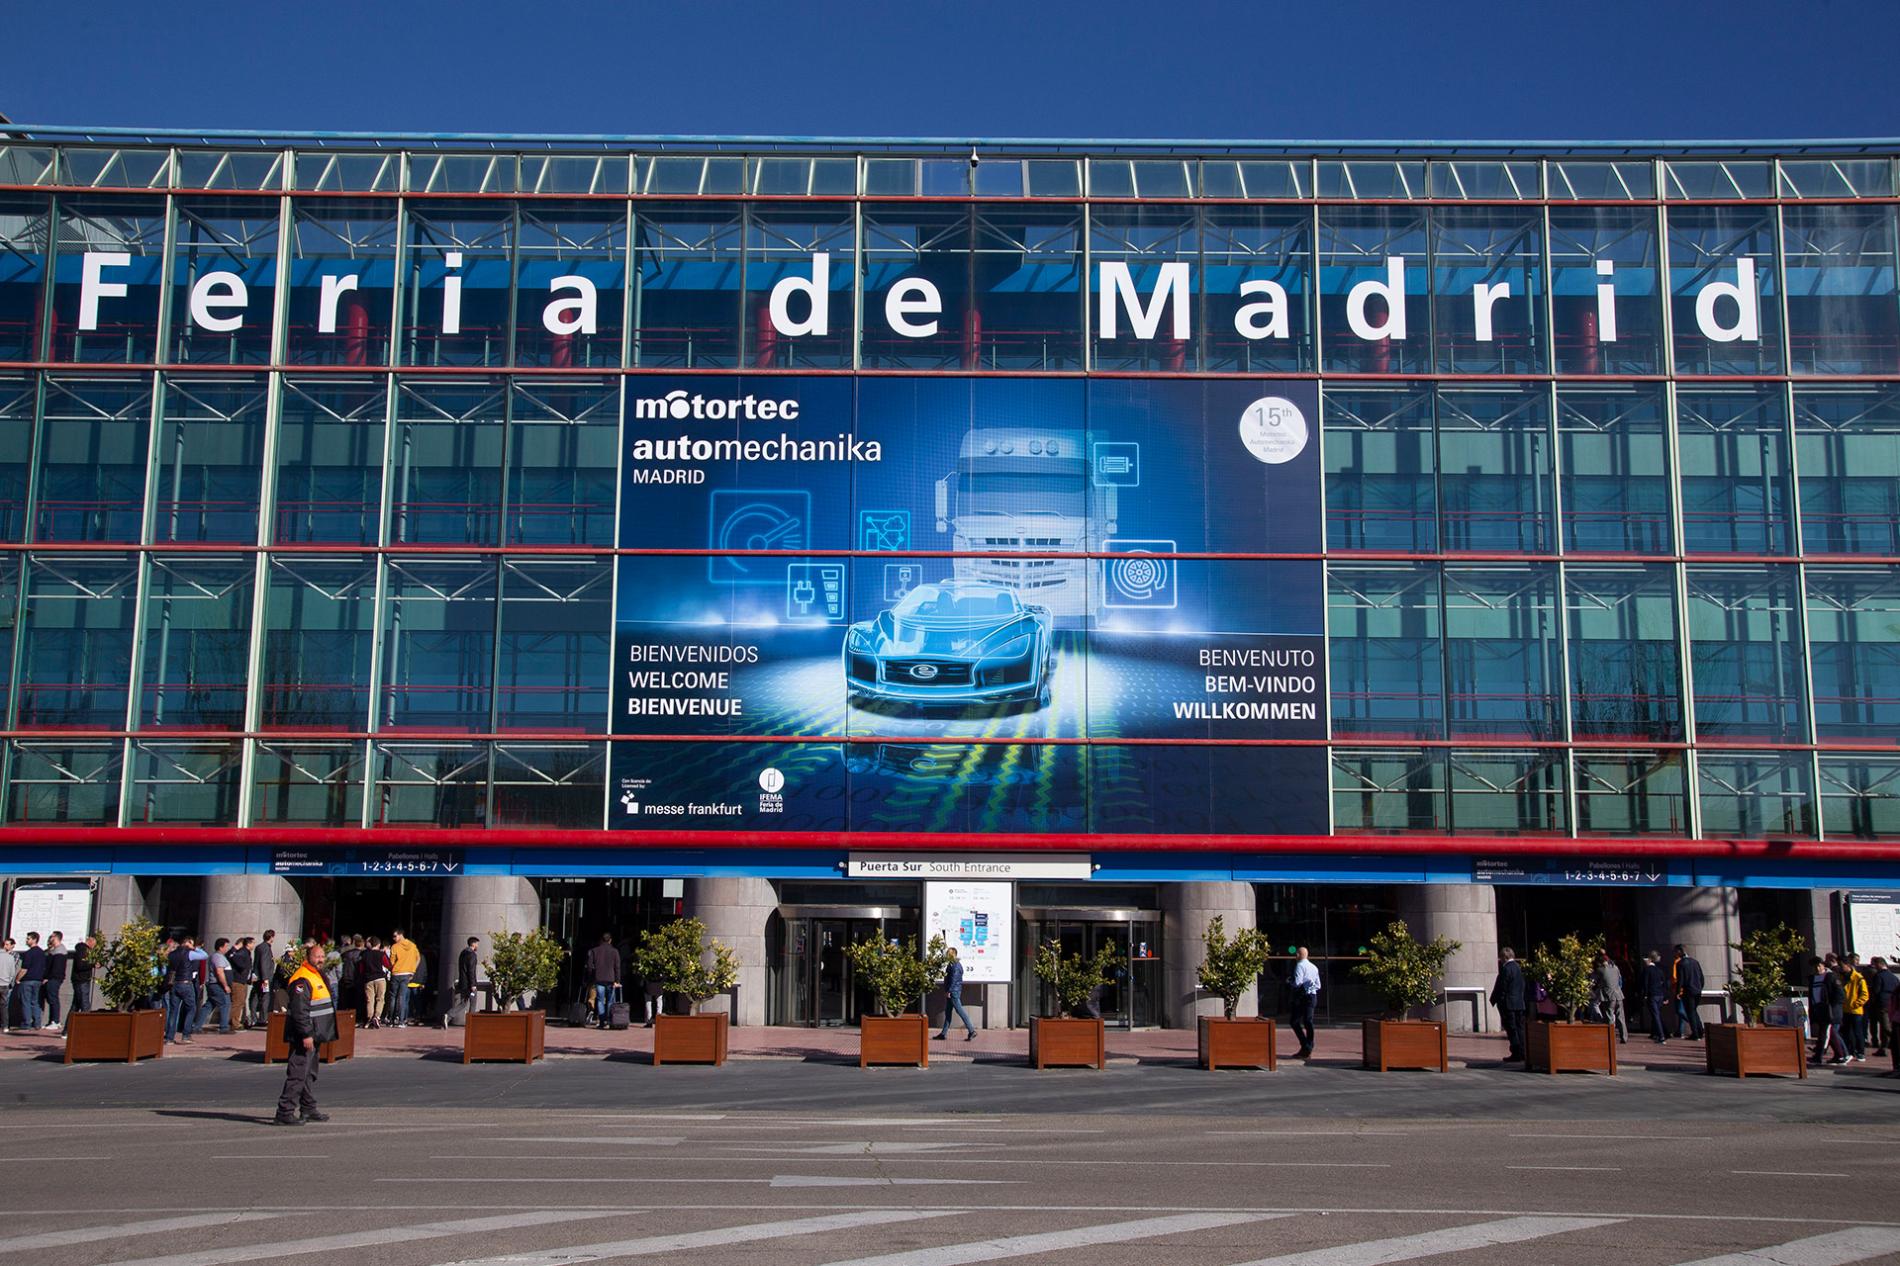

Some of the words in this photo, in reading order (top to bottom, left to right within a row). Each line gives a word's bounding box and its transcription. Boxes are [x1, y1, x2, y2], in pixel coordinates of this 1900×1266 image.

[78, 252, 597, 335] Feria
[769, 253, 942, 337] de
[1099, 257, 1759, 342] Madrid
[632, 433, 882, 462] automechanika
[633, 469, 705, 485] MADRID
[630, 645, 759, 664] BIENVENIDOS
[1200, 649, 1315, 667] BENVENUTO
[628, 671, 729, 689] WELCOME
[1205, 676, 1316, 693] BEM-VINDO
[628, 698, 742, 716] BIENVENUE
[1172, 702, 1316, 720] WILLKOMMEN
[644, 804, 685, 815] messe
[688, 802, 743, 815] frankfurt
[362, 861, 438, 871] 1-2-3-4-5-6-7
[860, 861, 899, 872] Puerta
[902, 862, 923, 872] Sur
[929, 861, 961, 873] South
[964, 862, 1011, 873] Entrance
[1564, 870, 1639, 880] 1-2-3-4-5-6-7
